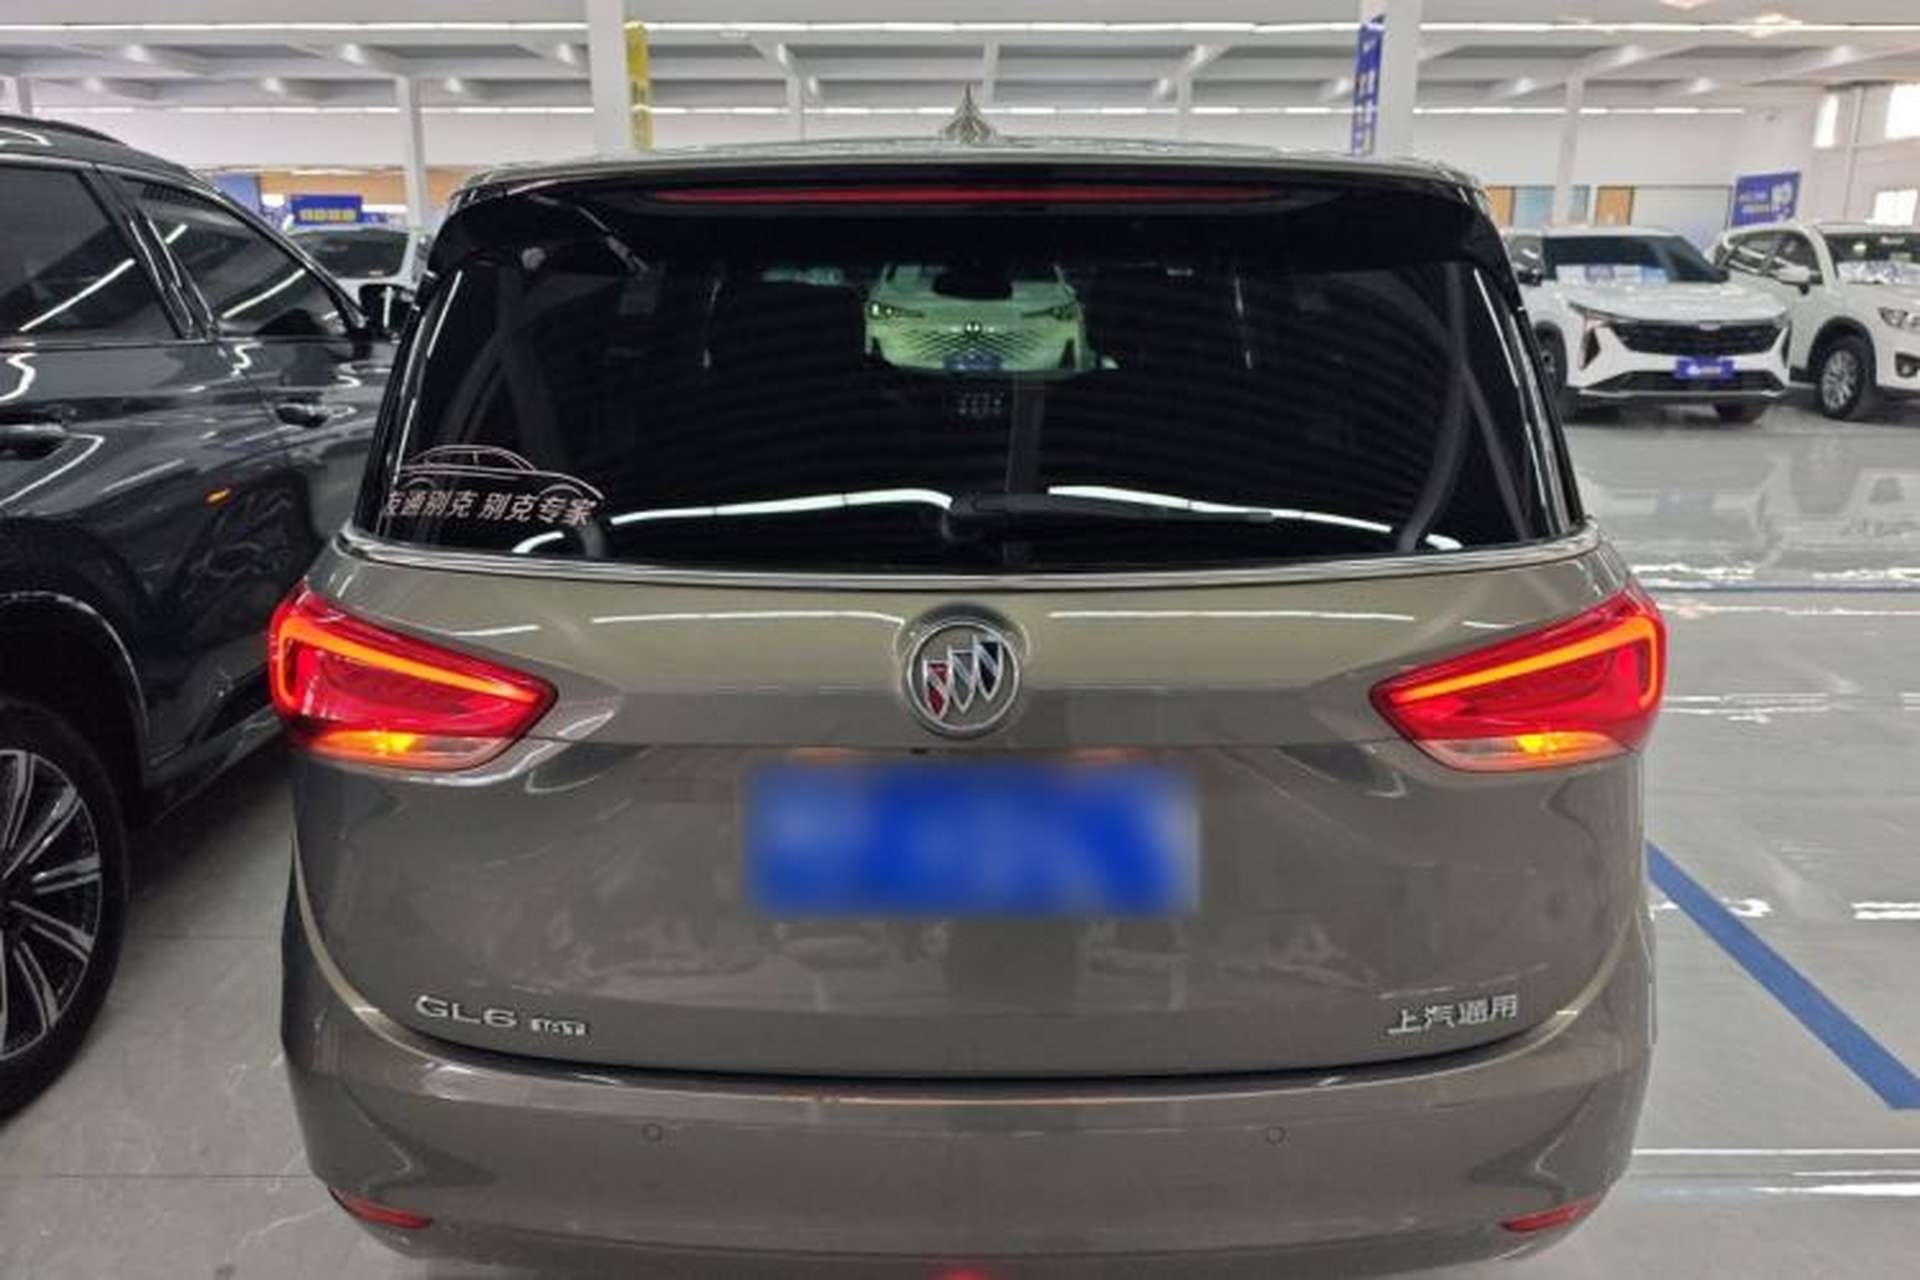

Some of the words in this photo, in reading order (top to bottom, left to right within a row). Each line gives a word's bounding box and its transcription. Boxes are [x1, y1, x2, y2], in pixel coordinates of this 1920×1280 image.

[478, 492, 597, 526] 别克专家
[415, 994, 517, 1028] GL6
[1387, 994, 1518, 1034] 上汽通用
